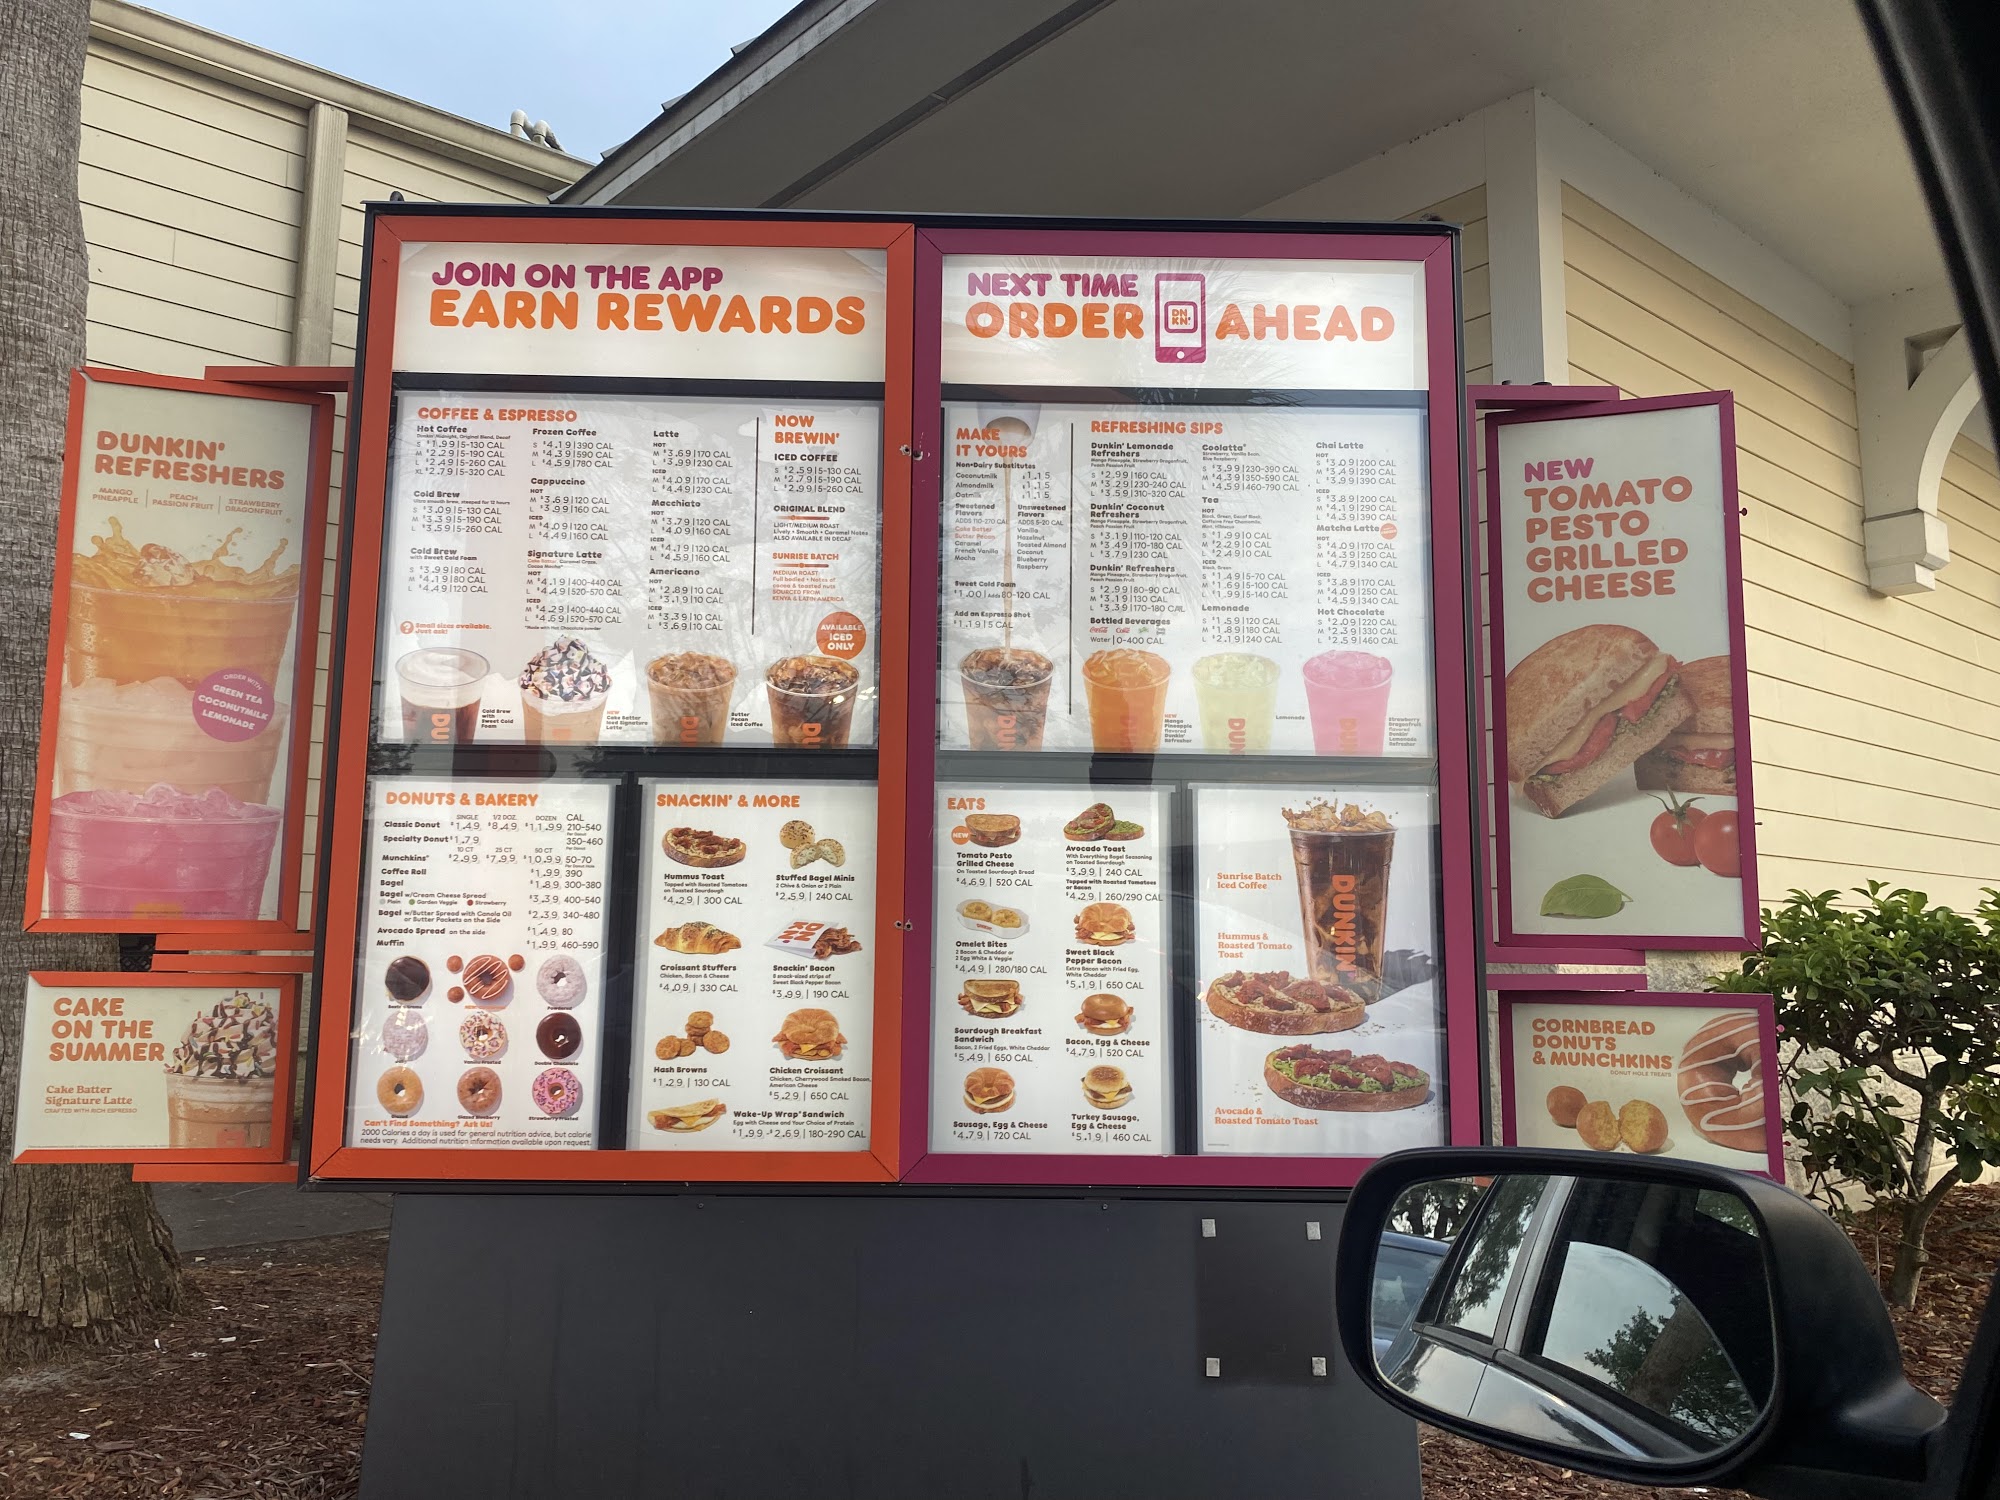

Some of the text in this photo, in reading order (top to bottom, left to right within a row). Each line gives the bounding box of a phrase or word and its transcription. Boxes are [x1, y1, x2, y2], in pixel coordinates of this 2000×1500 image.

[432, 262, 723, 291] JOIN ON THE APP
[967, 273, 1138, 298] NEXT TIME
[430, 290, 865, 335] EARN REWARDS
[965, 302, 1395, 342] ORDER AHEAD
[418, 407, 577, 422] COFFEE & ESPRESSO
[775, 415, 814, 427] NOW
[1091, 421, 1223, 434] REFRESHING SIPS
[654, 430, 679, 438] Latte
[775, 432, 840, 444] BREWIN'
[956, 428, 1000, 440] MAKE
[97, 431, 225, 461] DUNKIN'
[1339, 442, 1363, 450] Latte
[957, 445, 1027, 458] IT YOURS
[800, 454, 838, 462] COFFEE
[95, 454, 284, 489] REFRESHERS
[1524, 457, 1594, 483] NEW
[531, 478, 585, 486] Cappuccino
[93, 494, 139, 504] PINEAPPLE
[170, 493, 198, 501] PEACH
[1524, 476, 1692, 513] TOMATO
[152, 500, 214, 510] PASSION FRUIT
[229, 499, 280, 508] STRAWBERRY
[1202, 496, 1219, 504] Tea
[225, 506, 283, 516] DRAGONFRUIT
[774, 505, 815, 513] ORIGINAL
[1317, 524, 1352, 532] Matcha
[1526, 510, 1649, 544] PESTO
[527, 550, 602, 559] Signature Latte
[1526, 538, 1688, 572] GRILLED
[650, 568, 700, 576] Americano
[1527, 569, 1676, 603] CHEESE
[830, 633, 853, 641] ICED
[247, 676, 262, 690] WITH
[213, 684, 263, 705] GREEN TEA
[198, 694, 268, 721] COCONUTMILK
[202, 709, 255, 730] LEMONADE
[386, 792, 539, 807] DONUTS & BAKERY
[657, 794, 800, 808] SNACKIN' & MORE
[947, 797, 985, 810] EATS
[415, 821, 440, 829] Donut
[1066, 845, 1125, 853] Avocado Toast
[990, 852, 1012, 860] Pesto
[957, 860, 1014, 868] Grilled Cheese
[380, 879, 403, 887] Bagel
[776, 874, 855, 883] Stuffed Bagel Minis
[1238, 882, 1267, 890] Coffee
[1331, 874, 1358, 980] DUNKIN'
[377, 939, 404, 947] Muffin
[1258, 942, 1292, 950] Tomato
[1066, 957, 1095, 966] Pepper
[702, 964, 736, 972] Stuffers
[773, 964, 835, 972] Snackin' Bacon
[53, 997, 125, 1017] CAKE
[52, 1020, 154, 1039] ON THE
[954, 1028, 999, 1036] Sourdough
[1532, 1018, 1655, 1036] CORNBREAD
[1066, 1038, 1093, 1047] Bacon,
[1096, 1039, 1111, 1047] Egg
[1532, 1035, 1616, 1051] DONUTS
[49, 1042, 165, 1062] SUMMER
[1532, 1051, 1546, 1065] &
[677, 1066, 707, 1074] Browns
[770, 1067, 843, 1075] Chicken Croissant
[694, 1079, 730, 1087] 130 CAL
[46, 1086, 112, 1094] Cake Batter
[45, 1096, 133, 1106] Signature Latte
[1215, 1107, 1262, 1115] Avocado &
[953, 1121, 990, 1129] Sausage,
[993, 1122, 1008, 1130] Egg
[1215, 1117, 1253, 1125] Roasted
[1255, 1117, 1291, 1125] Tomato
